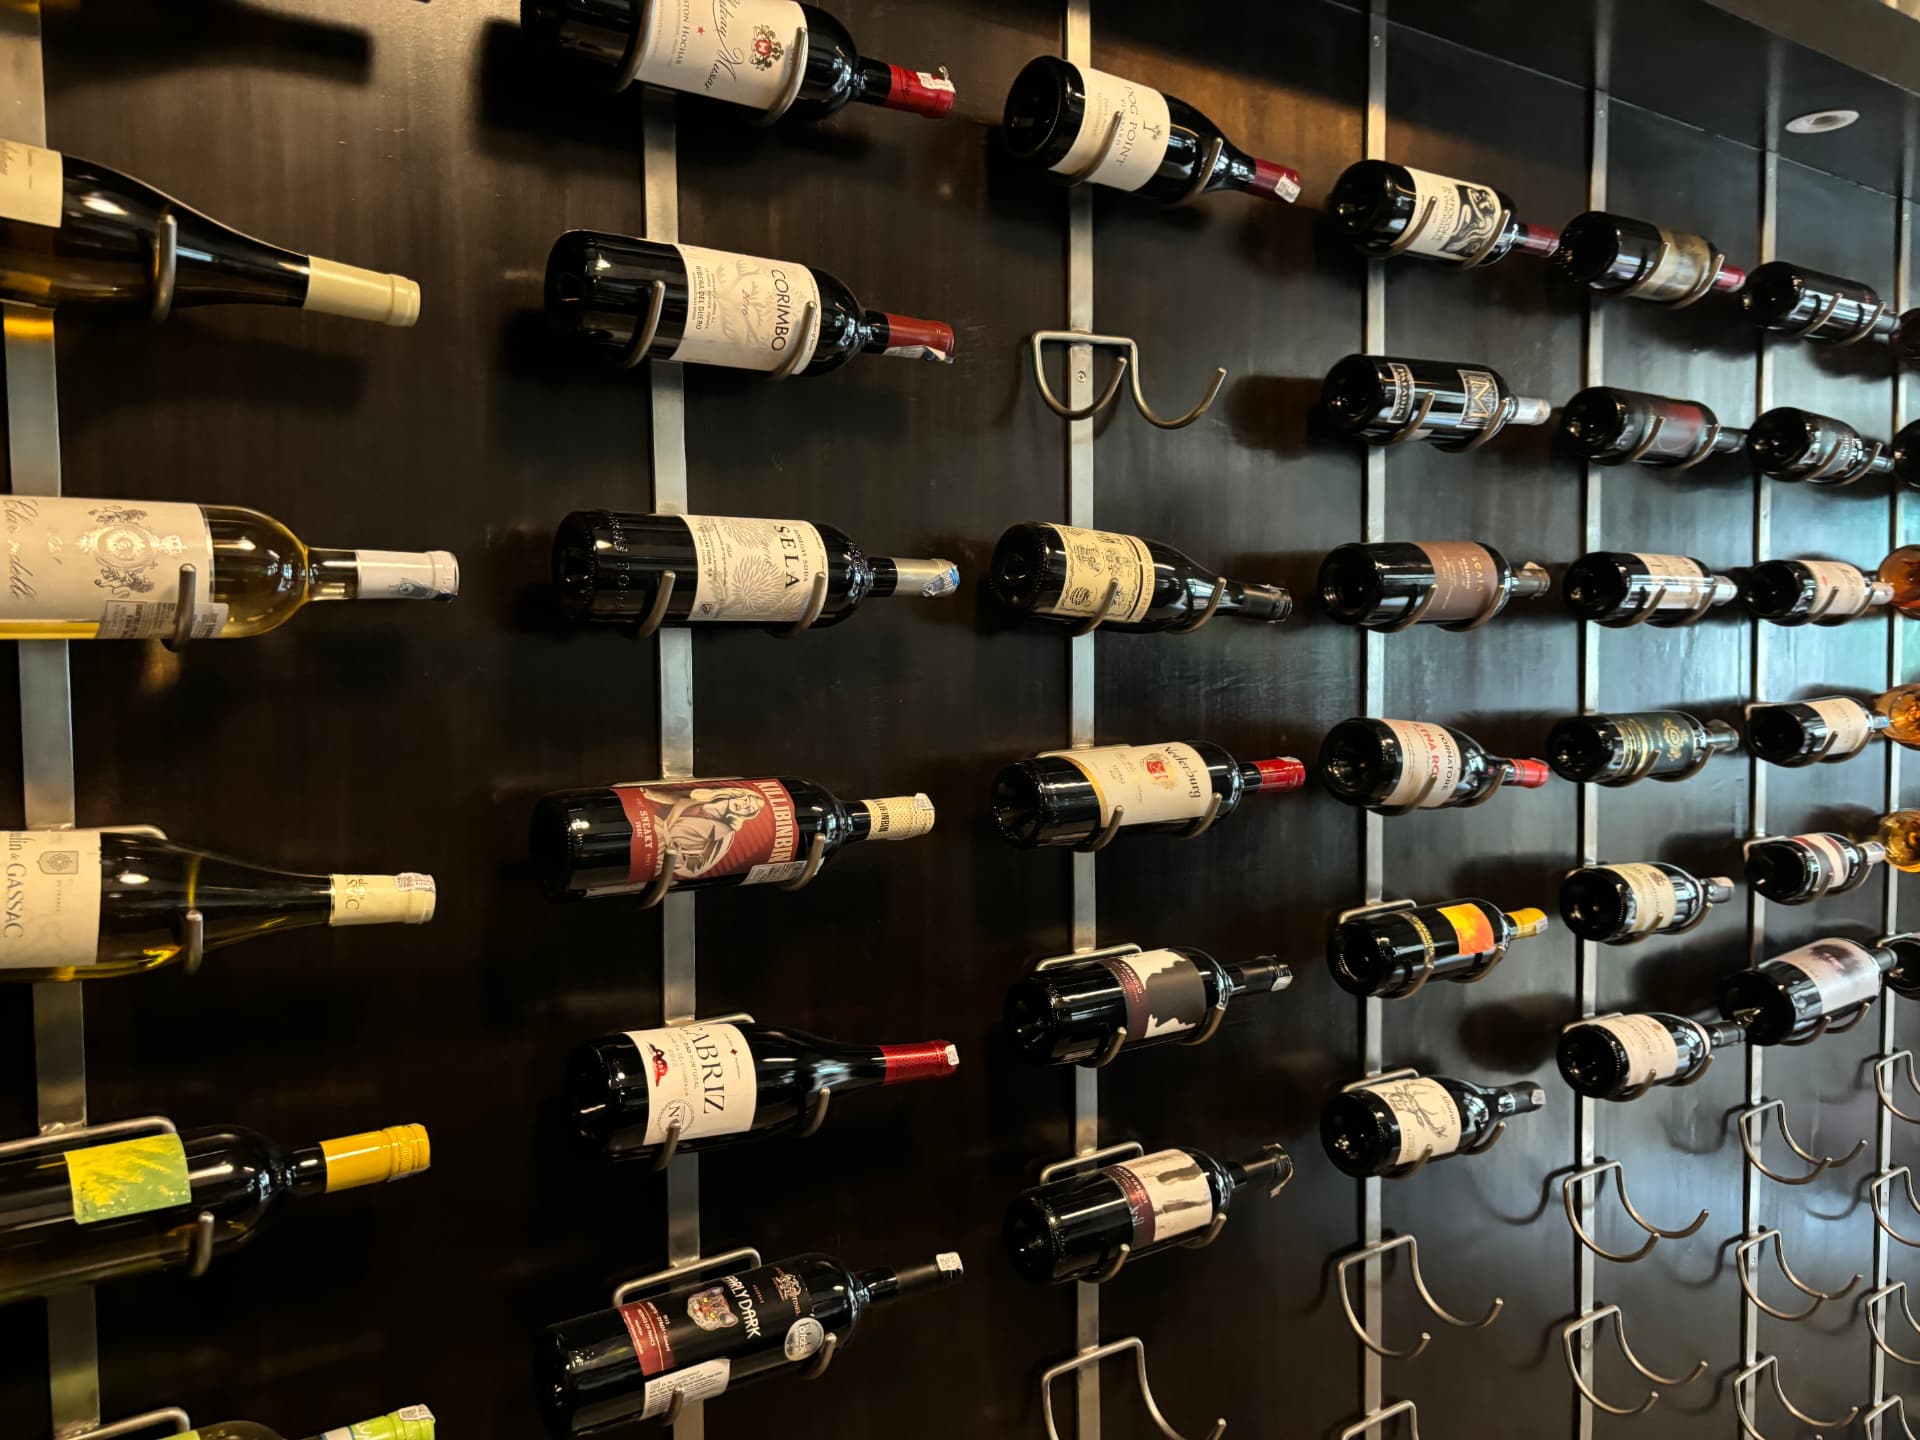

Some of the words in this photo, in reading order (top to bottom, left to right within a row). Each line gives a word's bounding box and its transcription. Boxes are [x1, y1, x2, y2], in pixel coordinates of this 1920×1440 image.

[1116, 121, 1138, 167] POINT
[771, 269, 791, 351] CORIMBO
[773, 525, 801, 590] SELA
[1164, 746, 1202, 798] Nederburg
[1438, 733, 1454, 791] TORNATORE
[639, 810, 653, 848] SNEAKY
[752, 782, 794, 864] KILLIBINBIN
[3, 863, 28, 939] GASSAC
[738, 1299, 762, 1340] DARK
